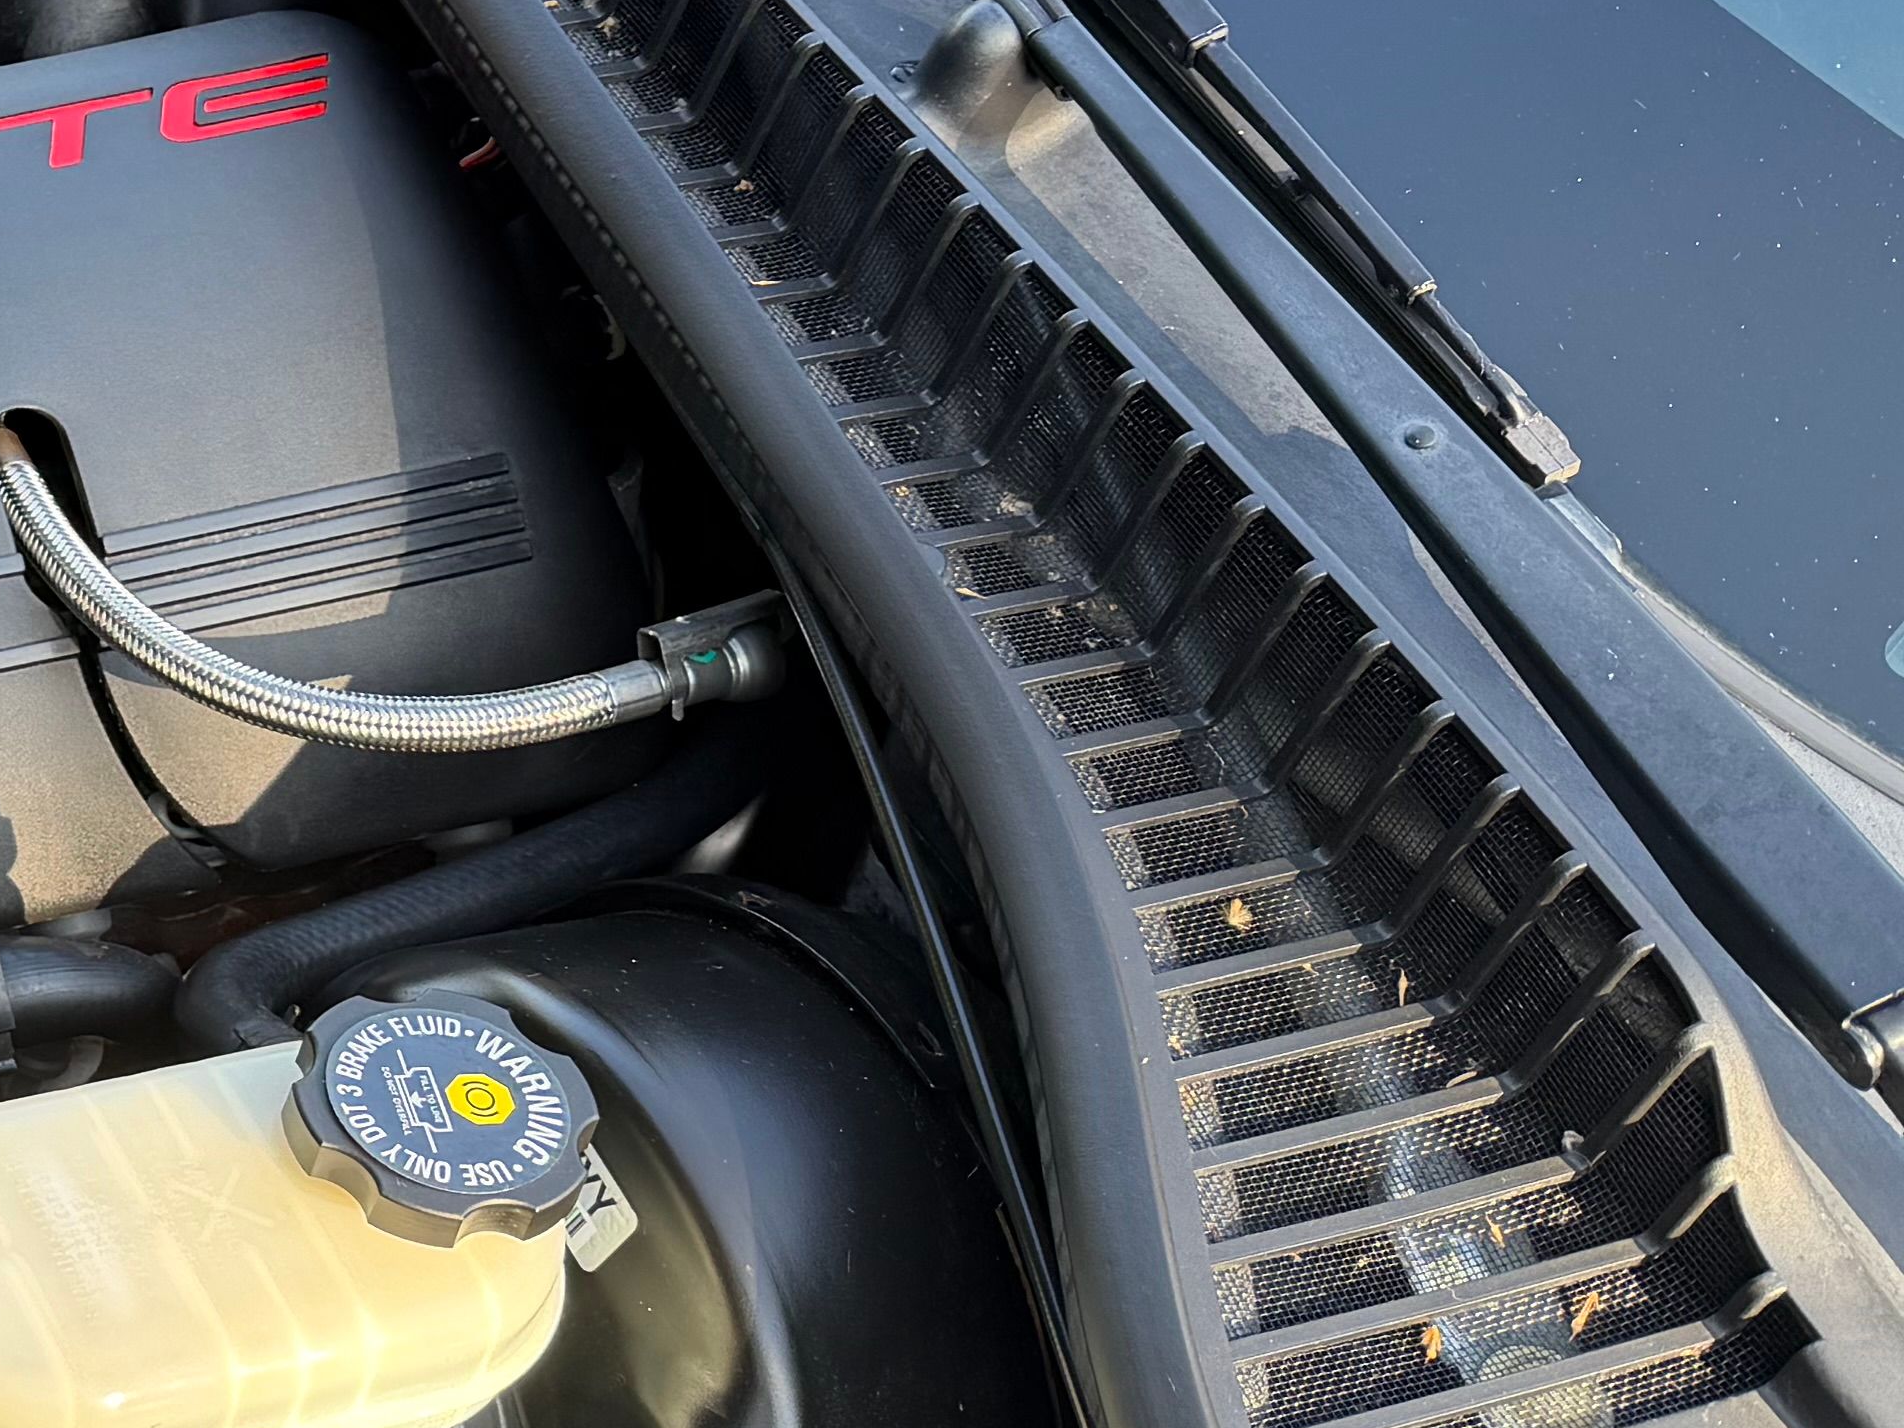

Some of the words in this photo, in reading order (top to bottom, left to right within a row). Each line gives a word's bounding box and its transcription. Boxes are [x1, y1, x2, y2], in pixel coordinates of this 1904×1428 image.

[387, 1015, 461, 1038] FLUID
[335, 1023, 392, 1080] BRAKE
[337, 1083, 363, 1098] 3
[475, 1030, 564, 1166] WARNING
[341, 1101, 388, 1144] DOT
[381, 1143, 452, 1184] ONLY
[459, 1159, 514, 1187] USE
